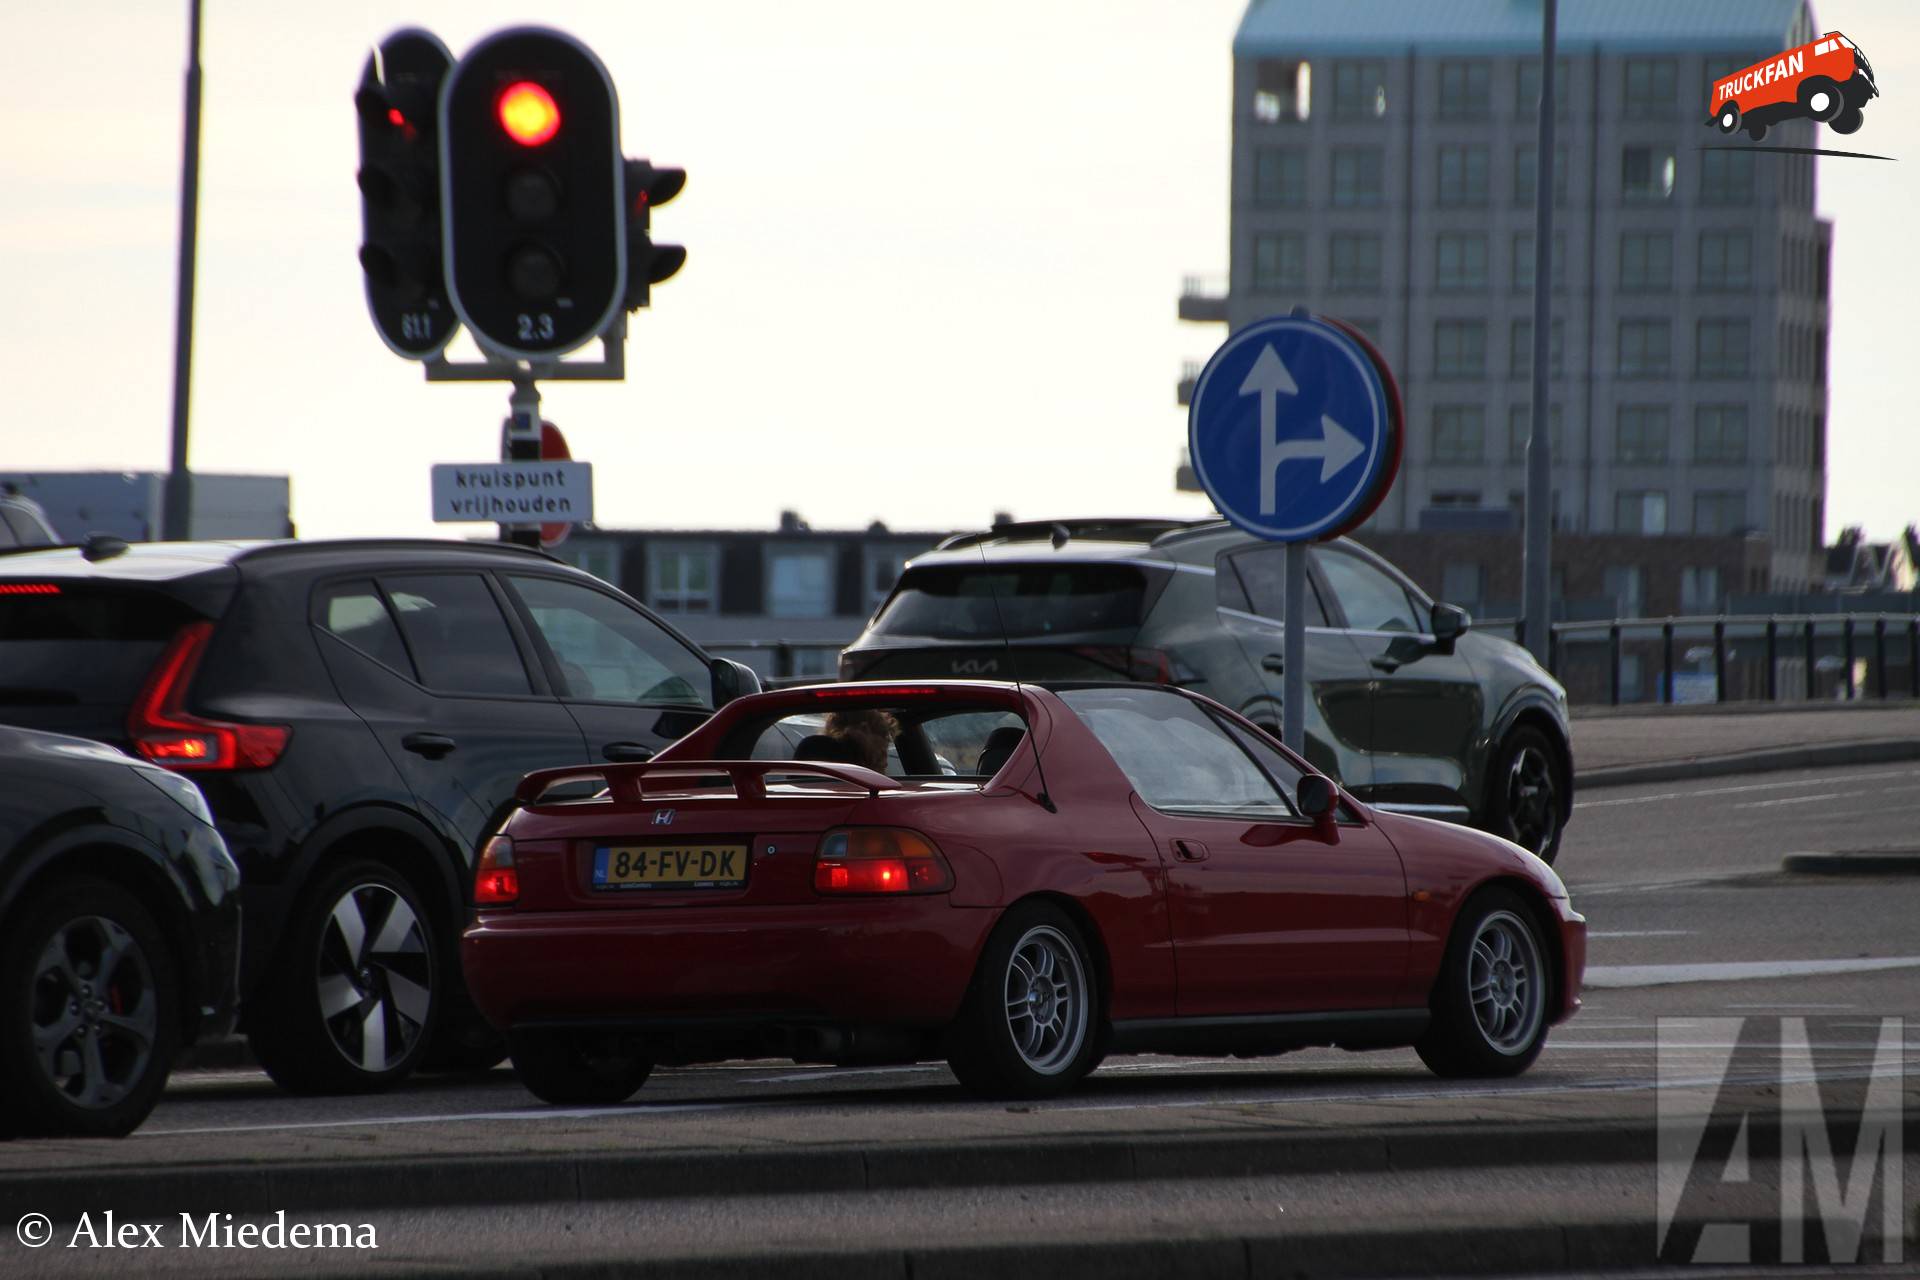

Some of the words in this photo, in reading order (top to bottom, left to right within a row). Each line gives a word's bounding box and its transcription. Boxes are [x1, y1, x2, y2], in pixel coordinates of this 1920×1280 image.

[517, 313, 554, 340] 2.3
[456, 468, 566, 490] kruispunt
[451, 494, 571, 518] vrijhouden
[615, 850, 735, 879] 84-FV-DK
